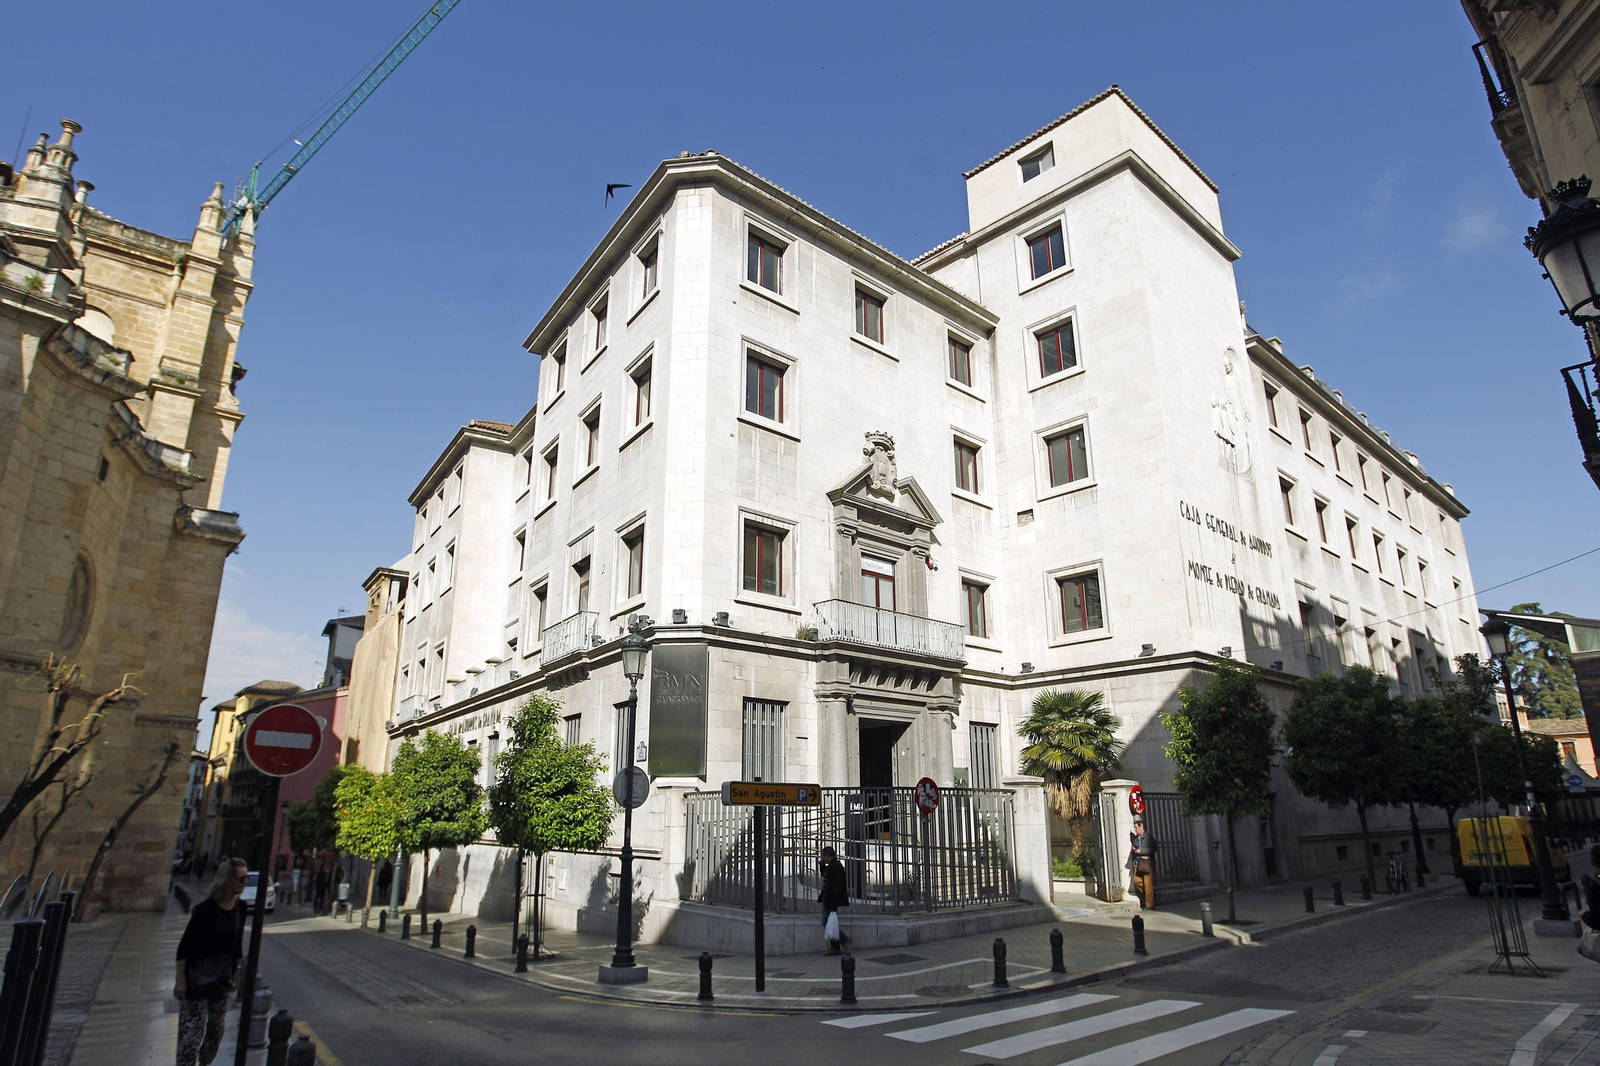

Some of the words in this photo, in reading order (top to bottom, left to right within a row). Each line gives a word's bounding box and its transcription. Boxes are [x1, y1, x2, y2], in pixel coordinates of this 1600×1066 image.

[1180, 500, 1201, 525] CAJA
[1205, 512, 1238, 542] GENERAL
[1188, 559, 1213, 585] MONTE
[1224, 574, 1245, 596] PIEDAD
[1255, 586, 1281, 610] GRANADA
[653, 668, 702, 693] BMN
[732, 788, 749, 797] San
